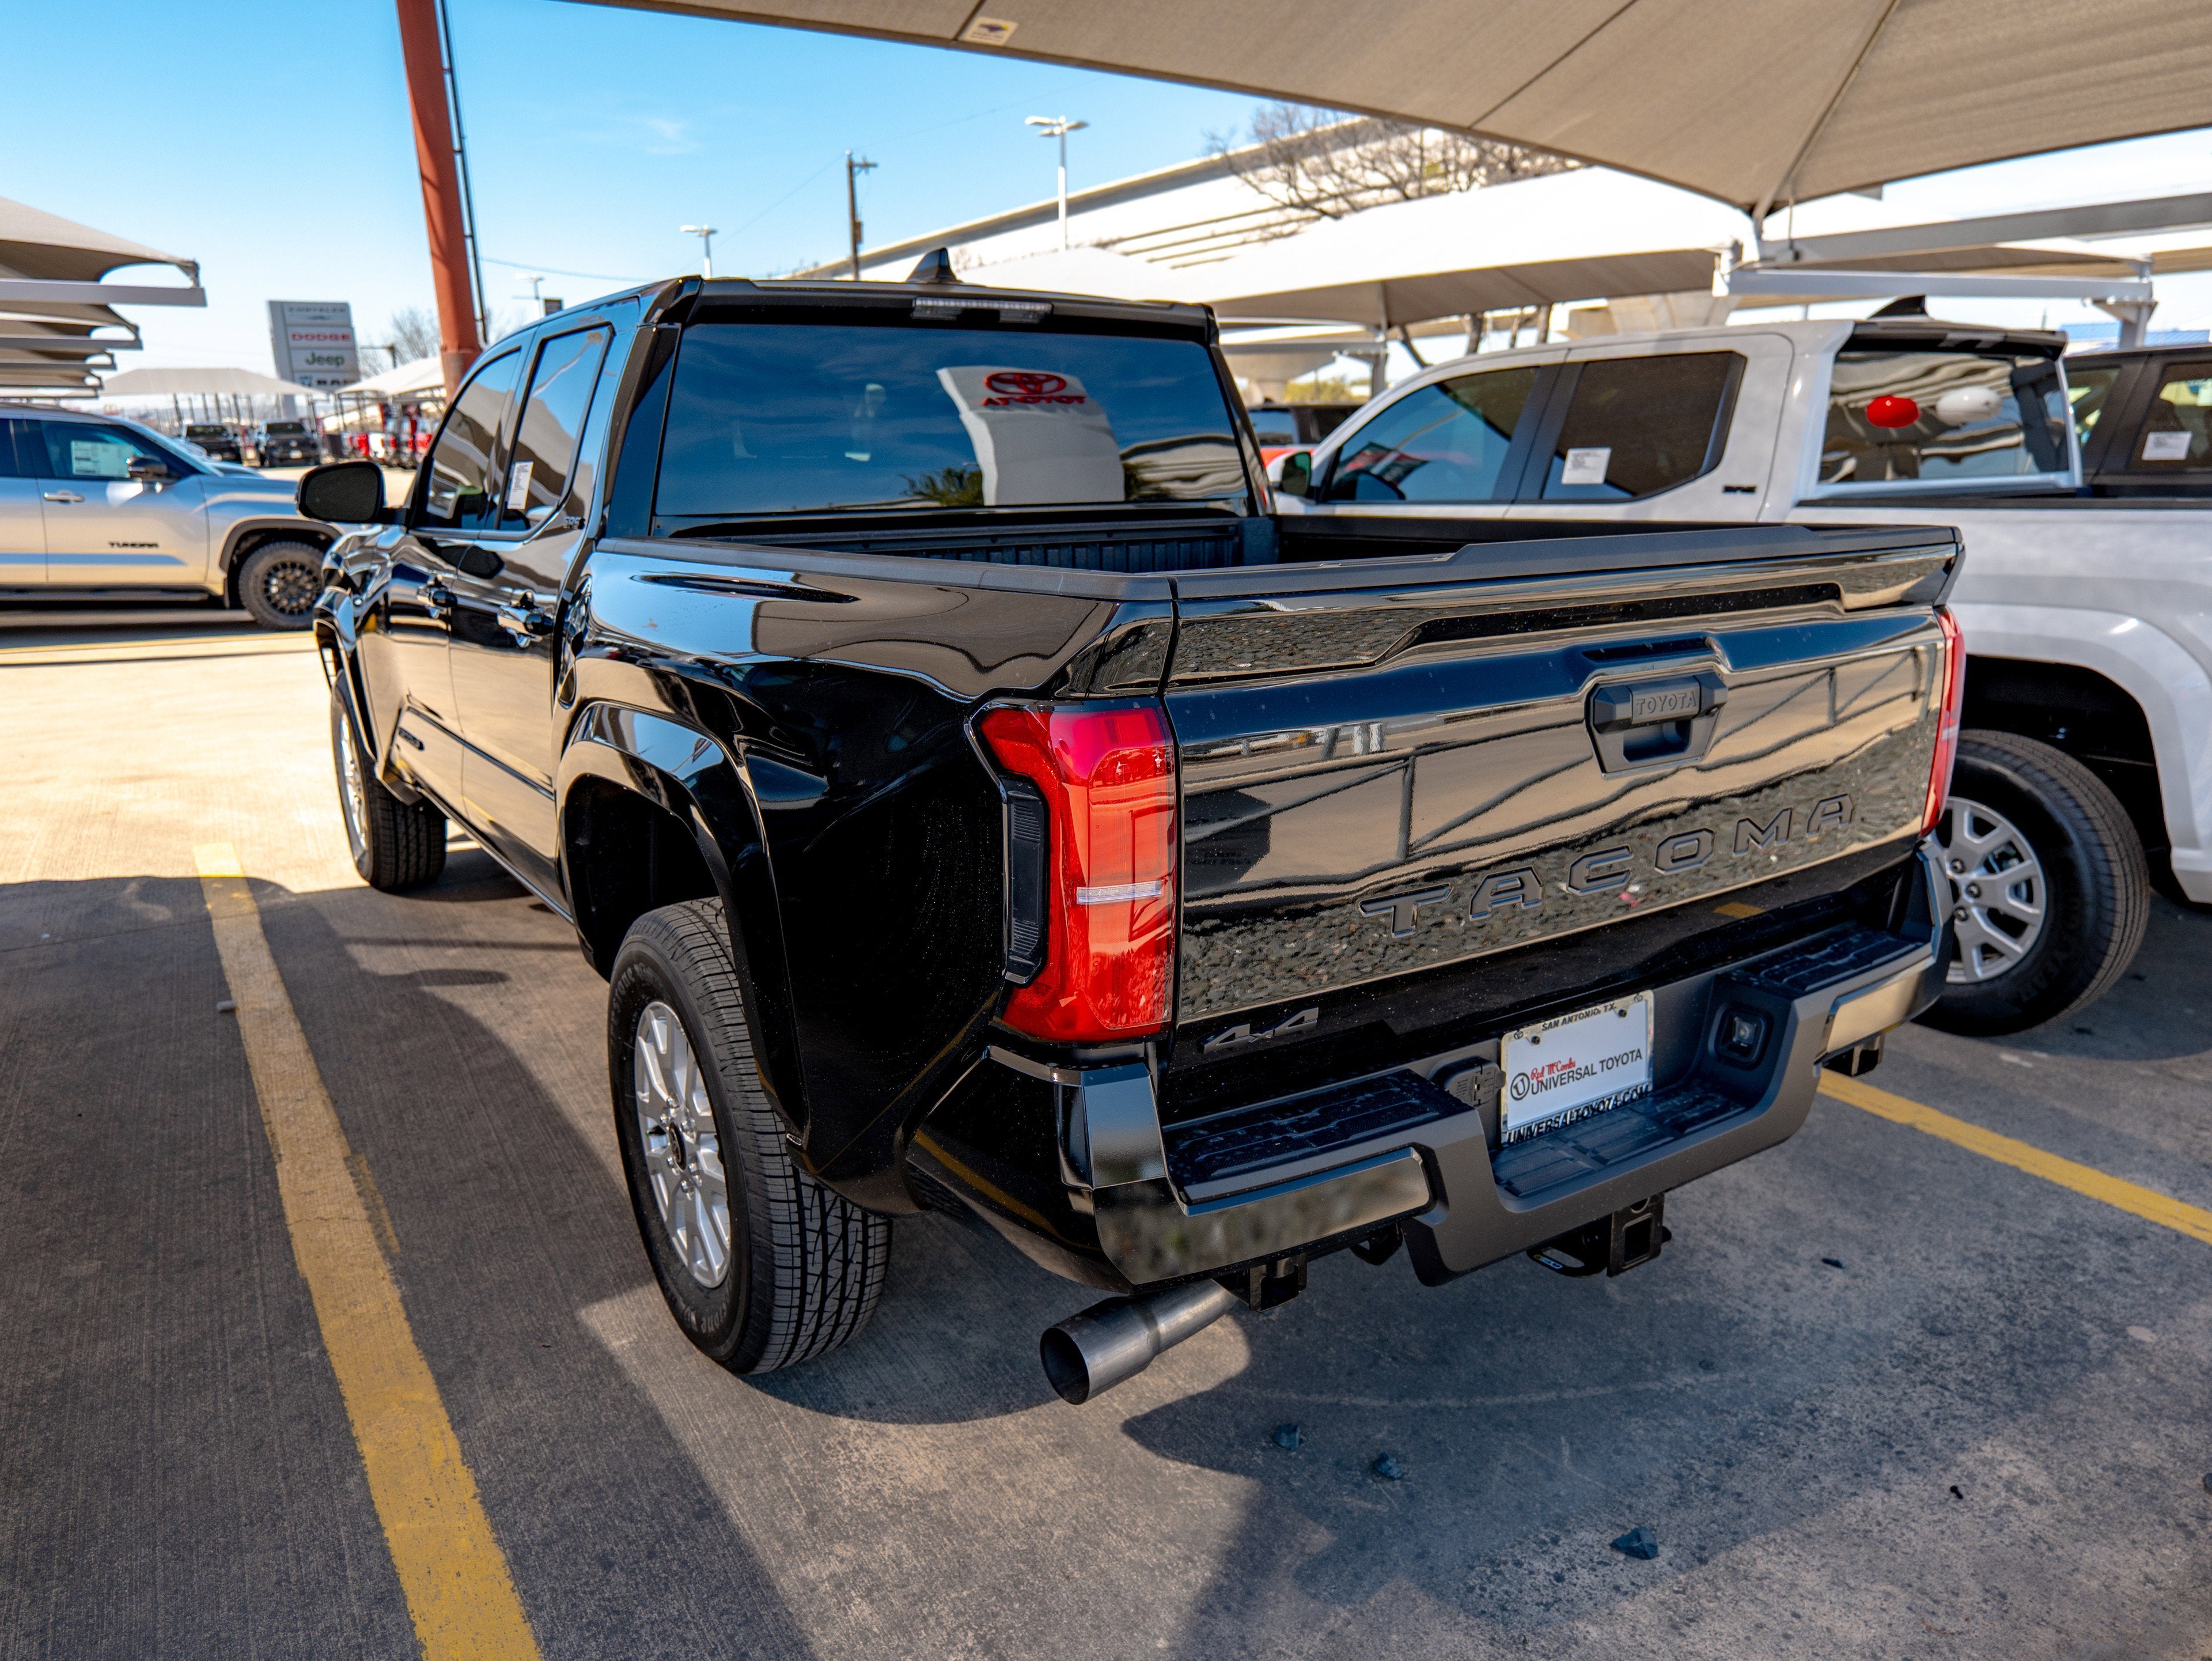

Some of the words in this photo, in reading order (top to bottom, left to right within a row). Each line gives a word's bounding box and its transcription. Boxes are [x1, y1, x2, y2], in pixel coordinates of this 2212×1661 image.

[291, 332, 351, 341] DODGE
[305, 351, 344, 368] Jeep
[1636, 692, 1698, 716] TOYOTA
[1357, 793, 1855, 939] TACOMA
[1541, 1019, 1560, 1031] SAN
[1531, 1064, 1597, 1095] UNIVERSAL
[1599, 1049, 1642, 1072] TOYOTA
[1531, 1066, 1545, 1084] Red
